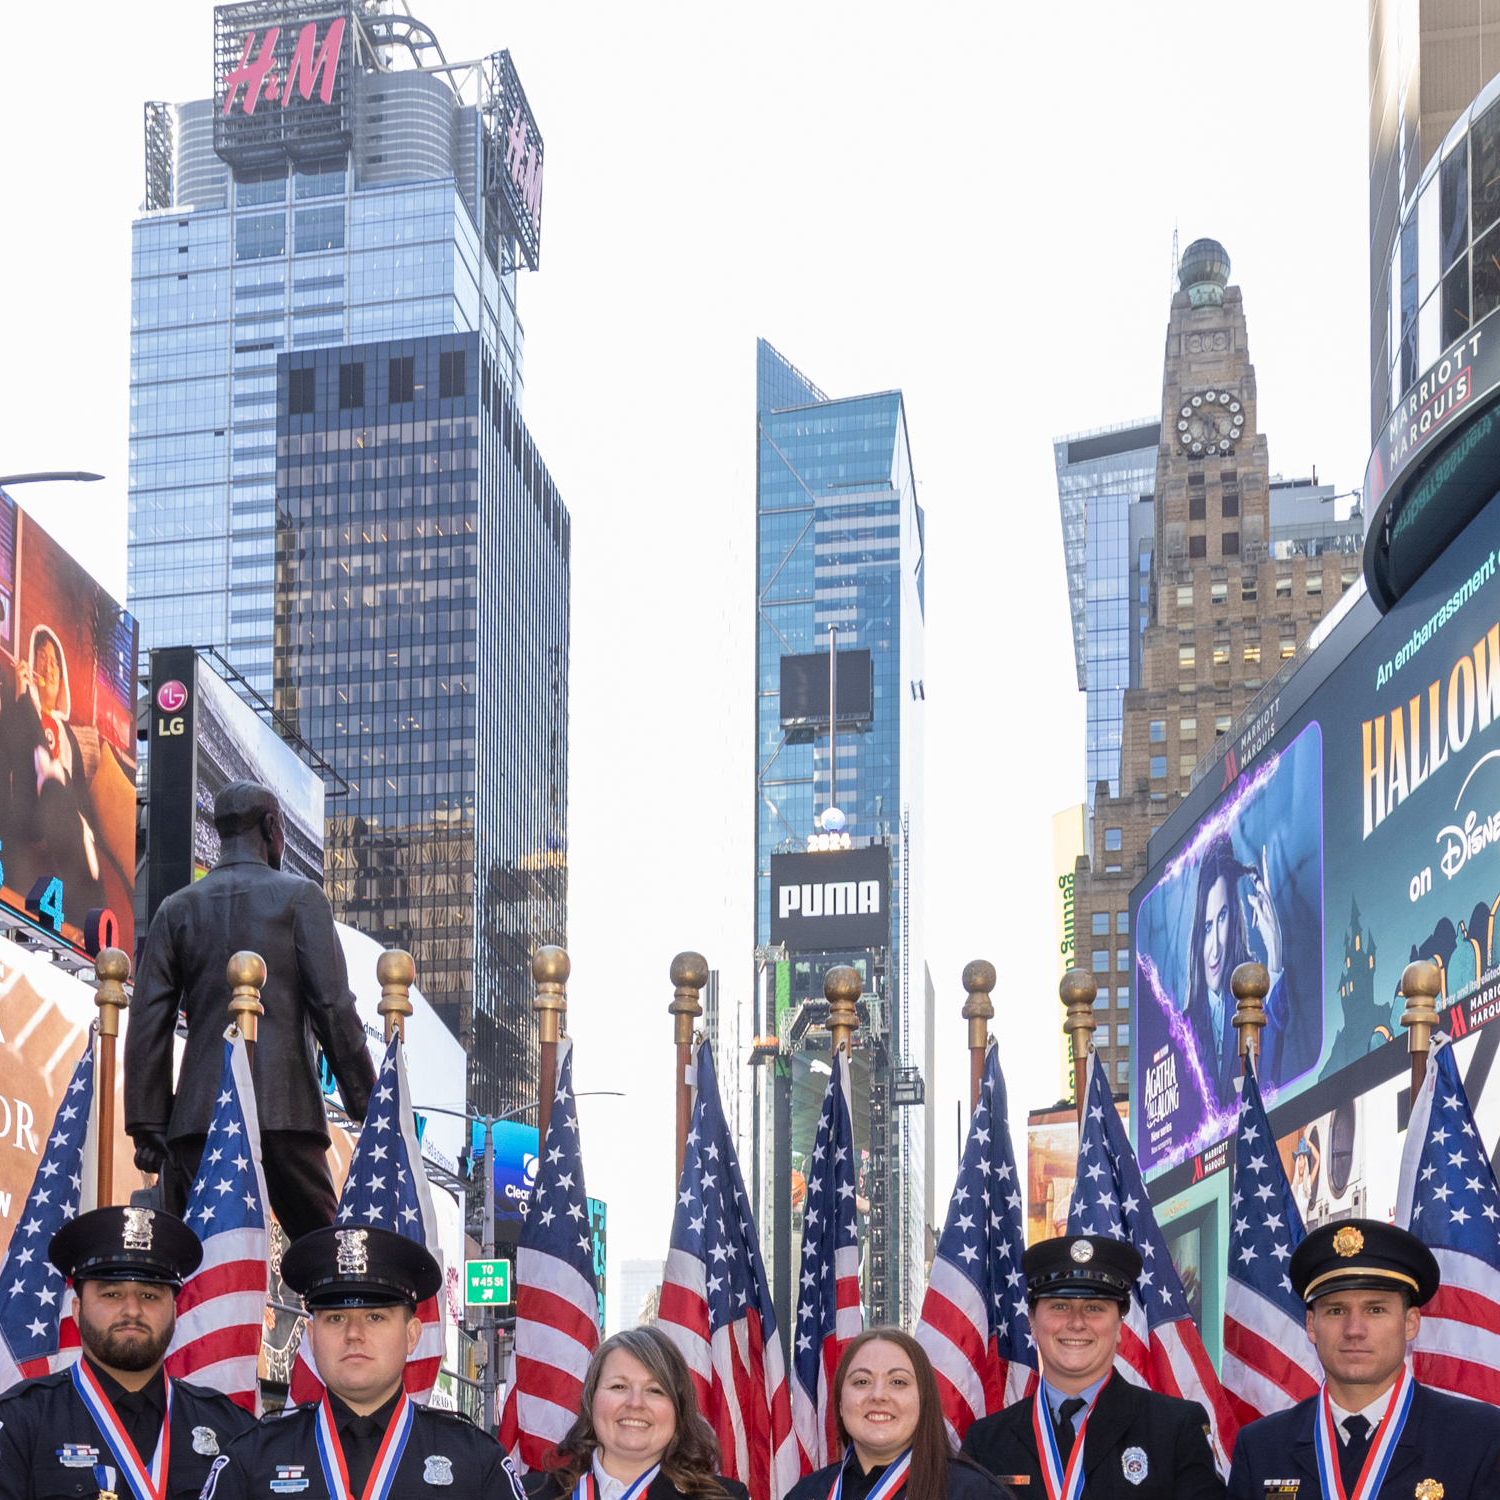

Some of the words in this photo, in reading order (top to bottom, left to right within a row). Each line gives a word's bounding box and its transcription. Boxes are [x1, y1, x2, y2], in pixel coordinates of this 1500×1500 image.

[223, 16, 346, 117] H&M
[507, 107, 544, 233] H&M
[1389, 331, 1482, 443] MARRIOTT
[1390, 376, 1467, 473] MARQUIS
[1376, 659, 1393, 691] An
[1395, 551, 1495, 672] embarrassment
[158, 717, 185, 737] LG
[1241, 697, 1280, 751] MARRIOTT
[1241, 722, 1276, 769] MARQUIS
[807, 832, 851, 853] 2024
[779, 879, 881, 920] PUMA
[1410, 866, 1431, 902] on
[1145, 1052, 1177, 1110] AGATHA
[1204, 1140, 1228, 1163] MARRIOTT
[1204, 1154, 1226, 1174] MARQUIS
[505, 1183, 530, 1200] Clear
[471, 1277, 481, 1287] W
[480, 1277, 493, 1287] 45
[494, 1276, 504, 1287] St
[481, 1264, 494, 1275] TO
